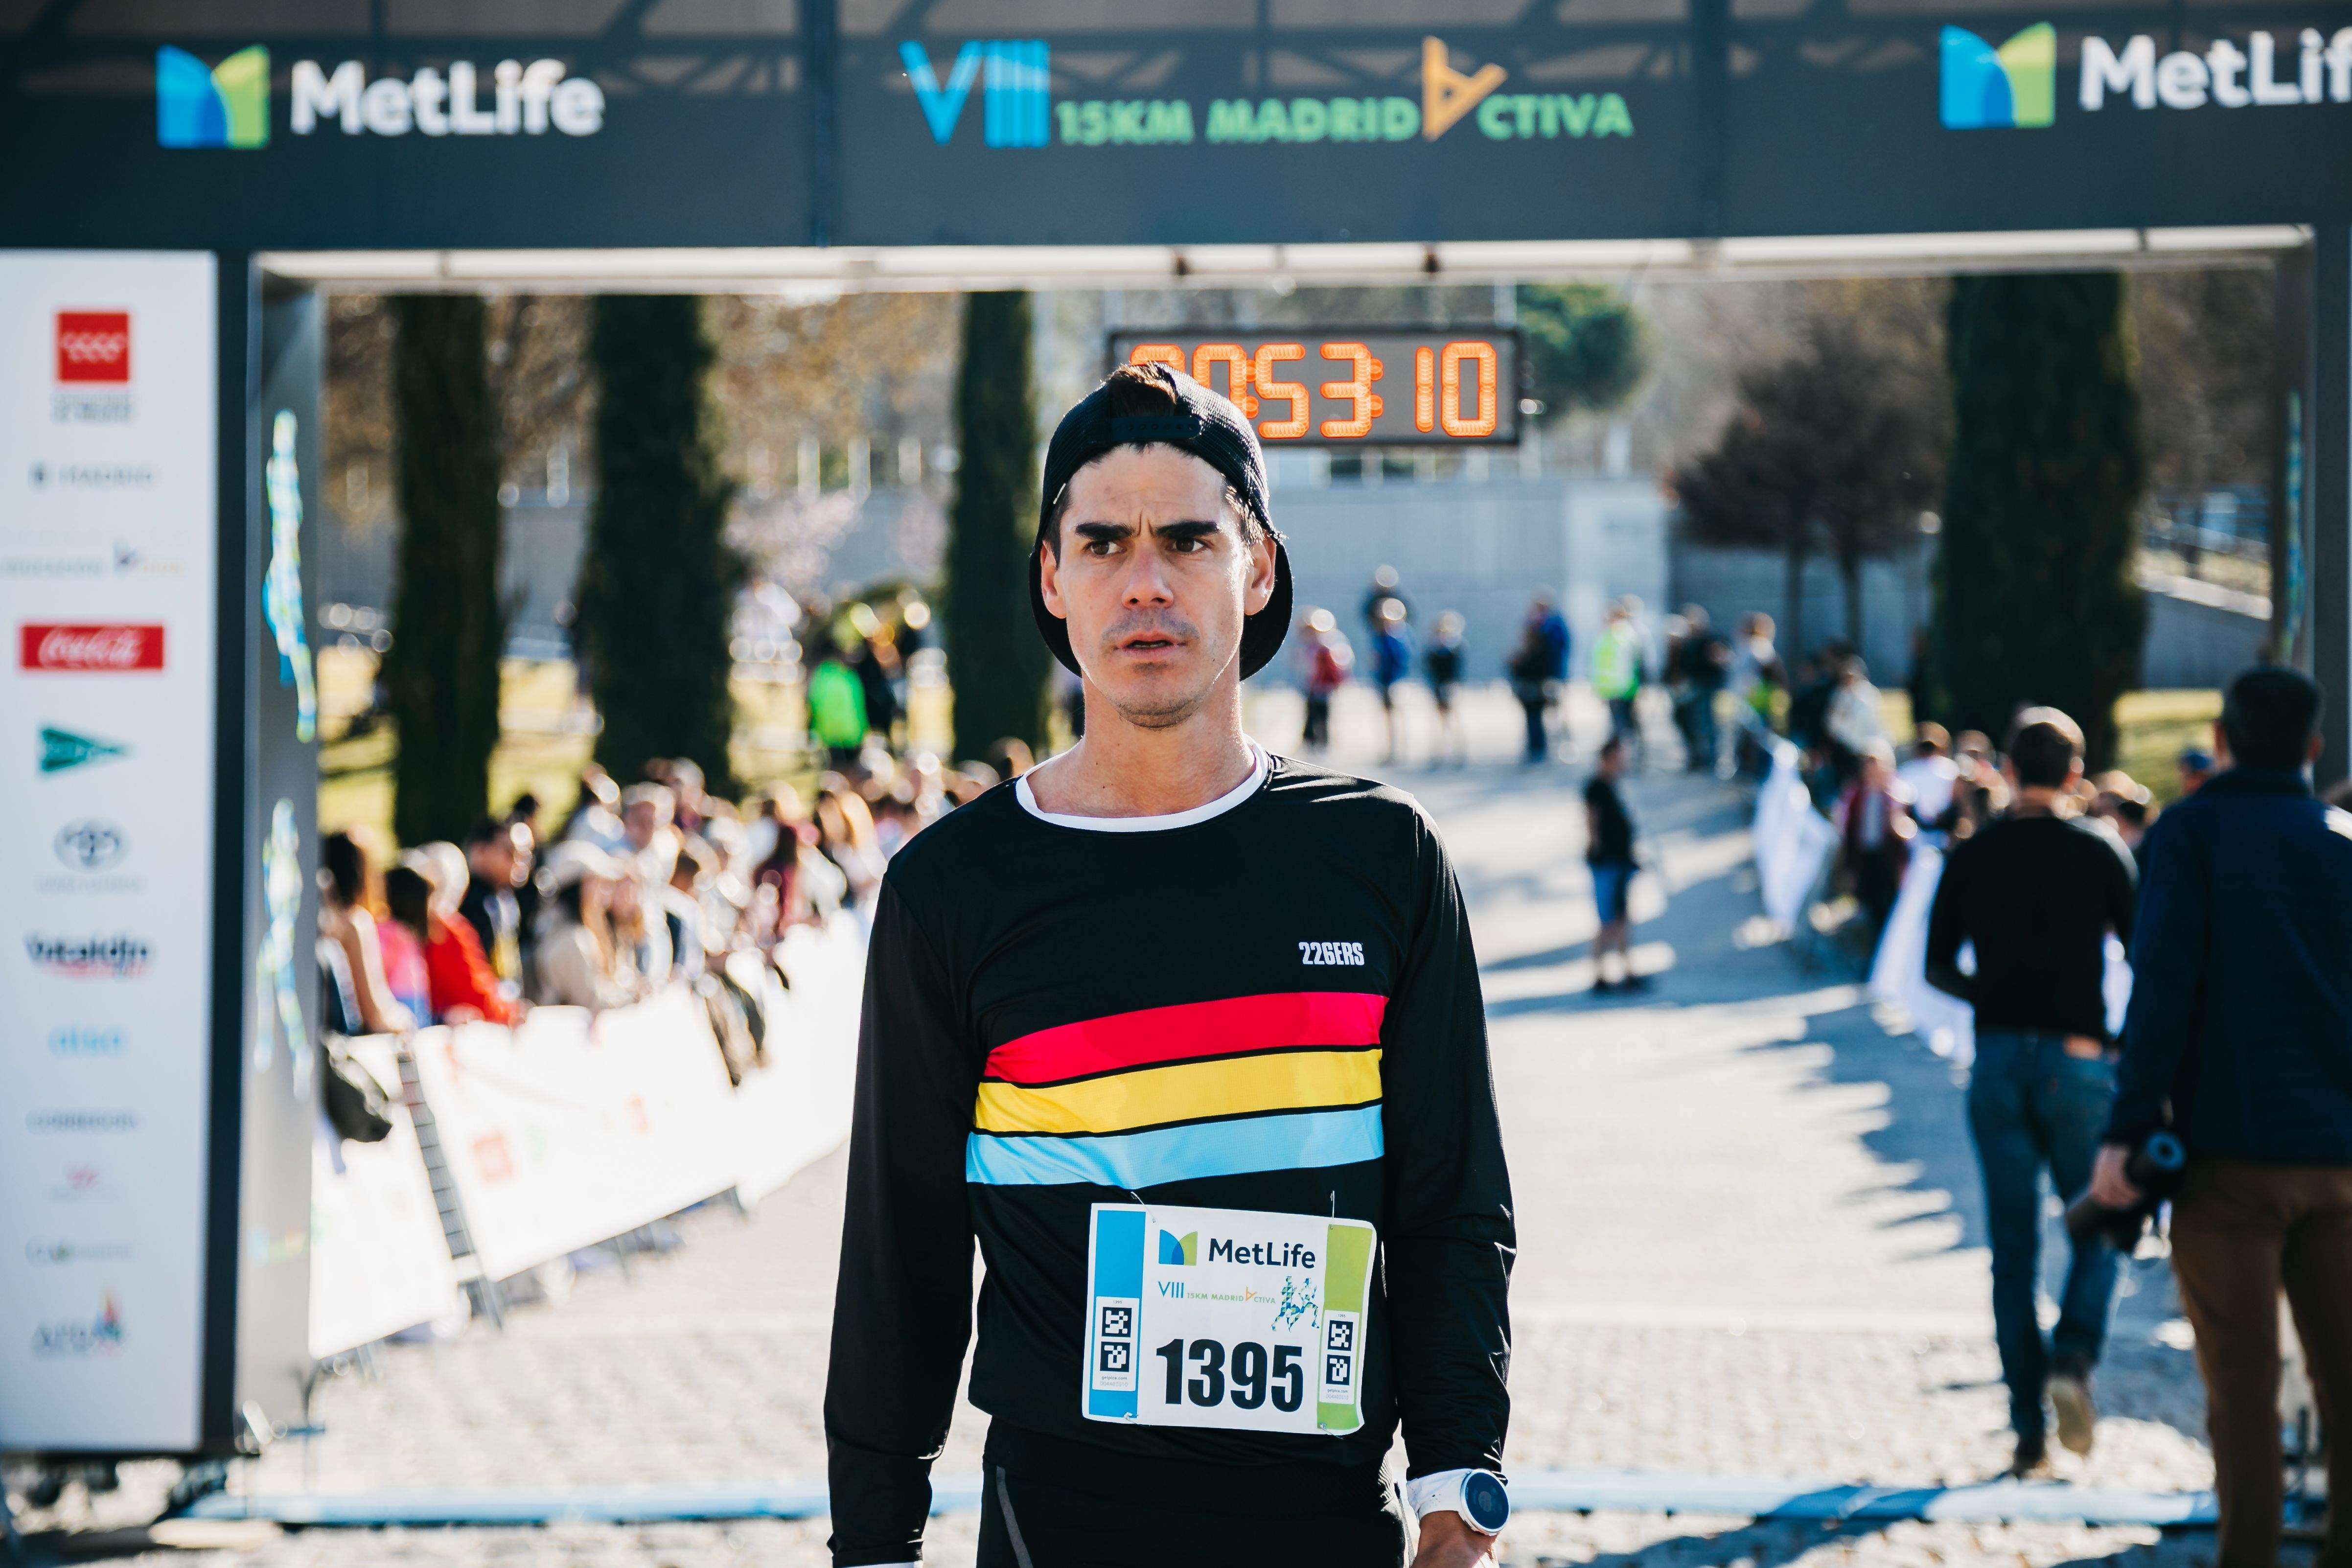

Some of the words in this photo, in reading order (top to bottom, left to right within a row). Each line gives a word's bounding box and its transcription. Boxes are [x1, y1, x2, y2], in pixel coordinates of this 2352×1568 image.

[291, 60, 606, 137] MetLife
[898, 39, 1051, 149] VIII
[1055, 99, 1194, 146] 15KM
[1205, 97, 1420, 145] MADRID
[1298, 942, 1365, 966] 226ERS
[1209, 1238, 1316, 1269] MetLife
[1158, 1281, 1185, 1298] VIII
[1156, 1338, 1304, 1412] 1395
